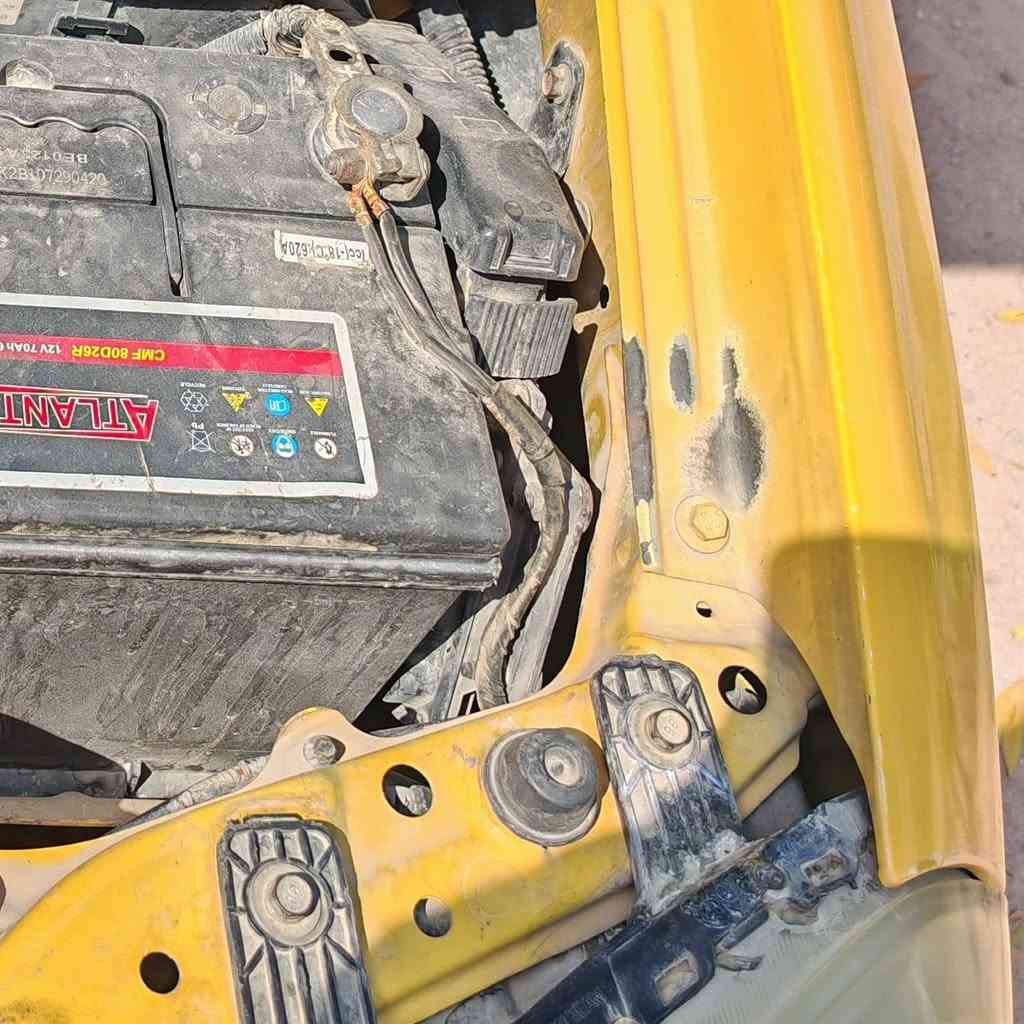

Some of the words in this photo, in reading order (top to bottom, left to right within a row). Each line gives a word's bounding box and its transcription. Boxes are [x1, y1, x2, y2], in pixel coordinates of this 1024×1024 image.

[6, 342, 37, 353] 70Ah
[40, 343, 62, 355] 12V
[71, 345, 128, 358] 80D26R
[131, 348, 165, 361] CMF
